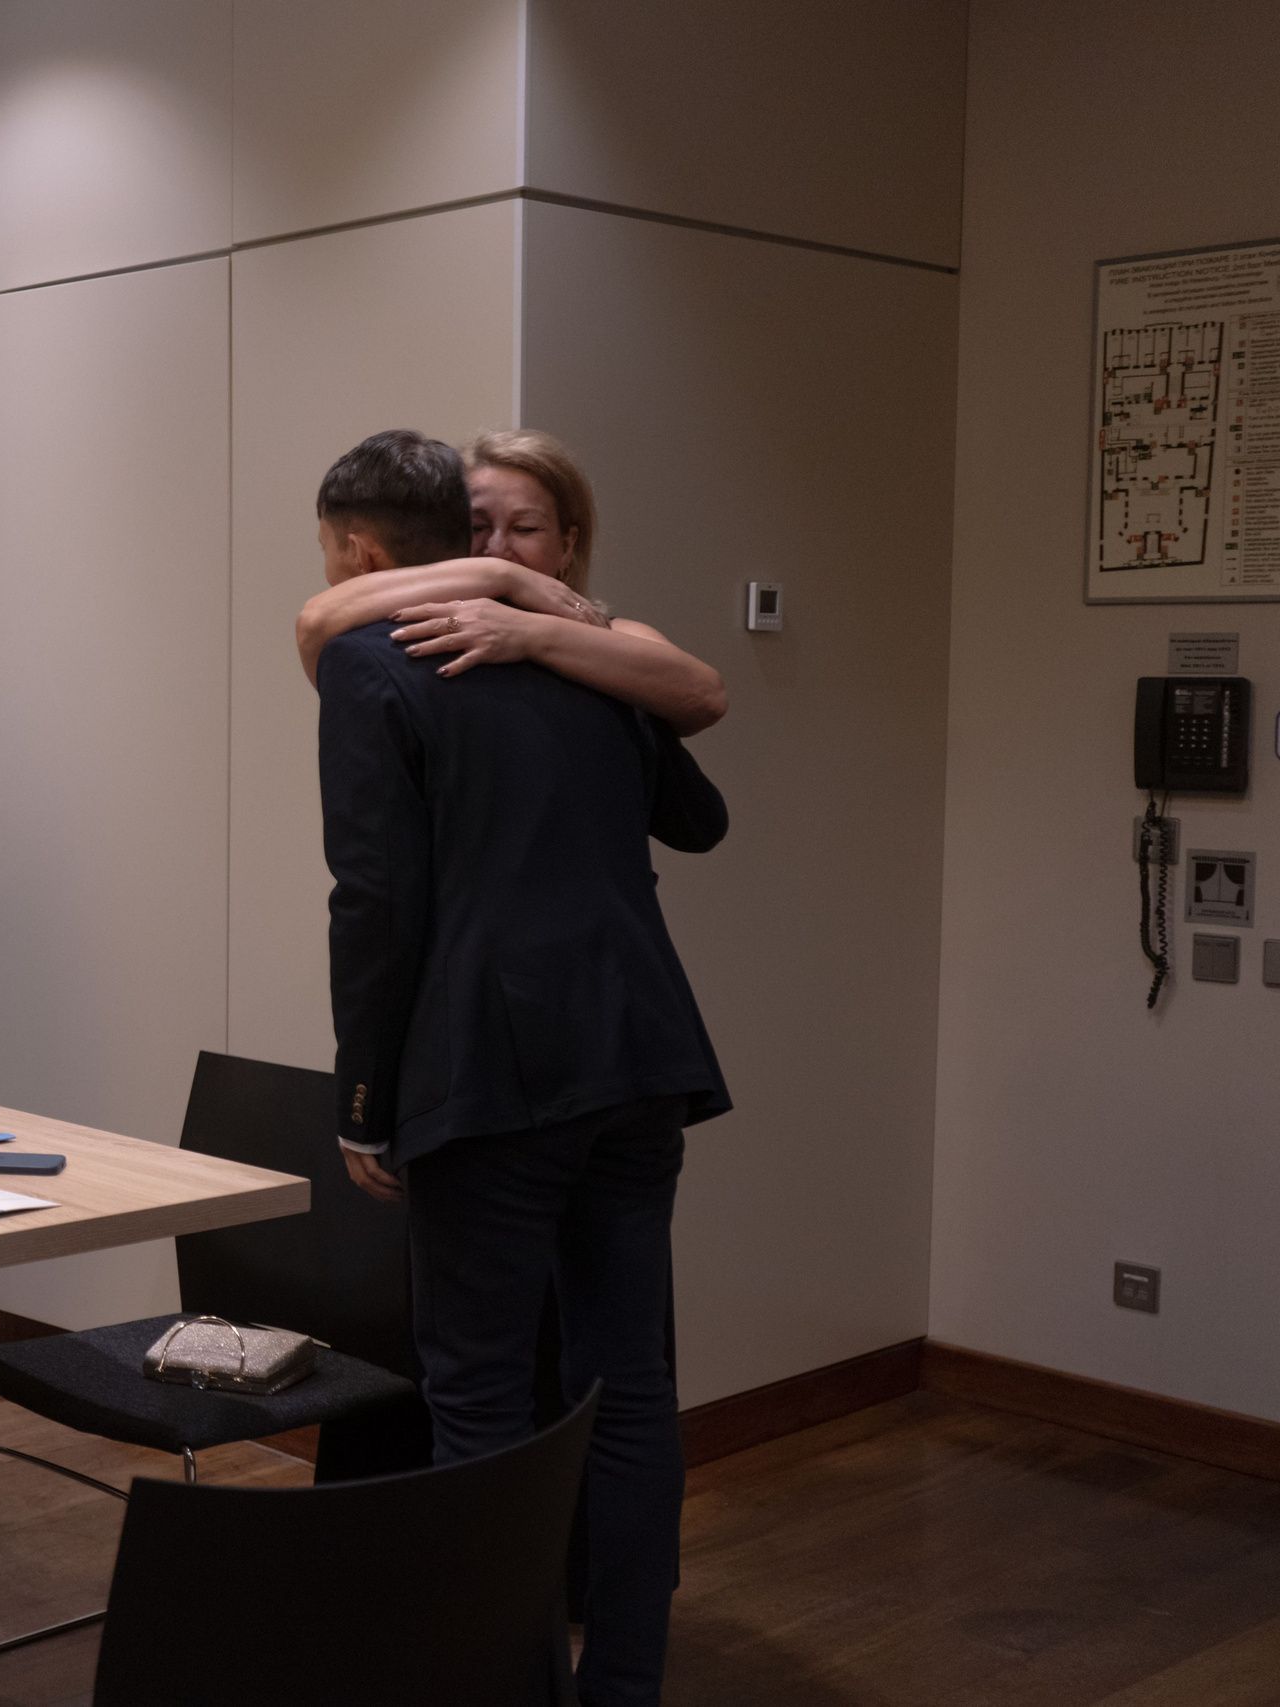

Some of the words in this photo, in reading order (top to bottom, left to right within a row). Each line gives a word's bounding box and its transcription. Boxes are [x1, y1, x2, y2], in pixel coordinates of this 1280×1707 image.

[1109, 277, 1130, 285] FIRE
[1132, 270, 1194, 283] INSTRUCTION
[1195, 265, 1230, 275] NOTICE
